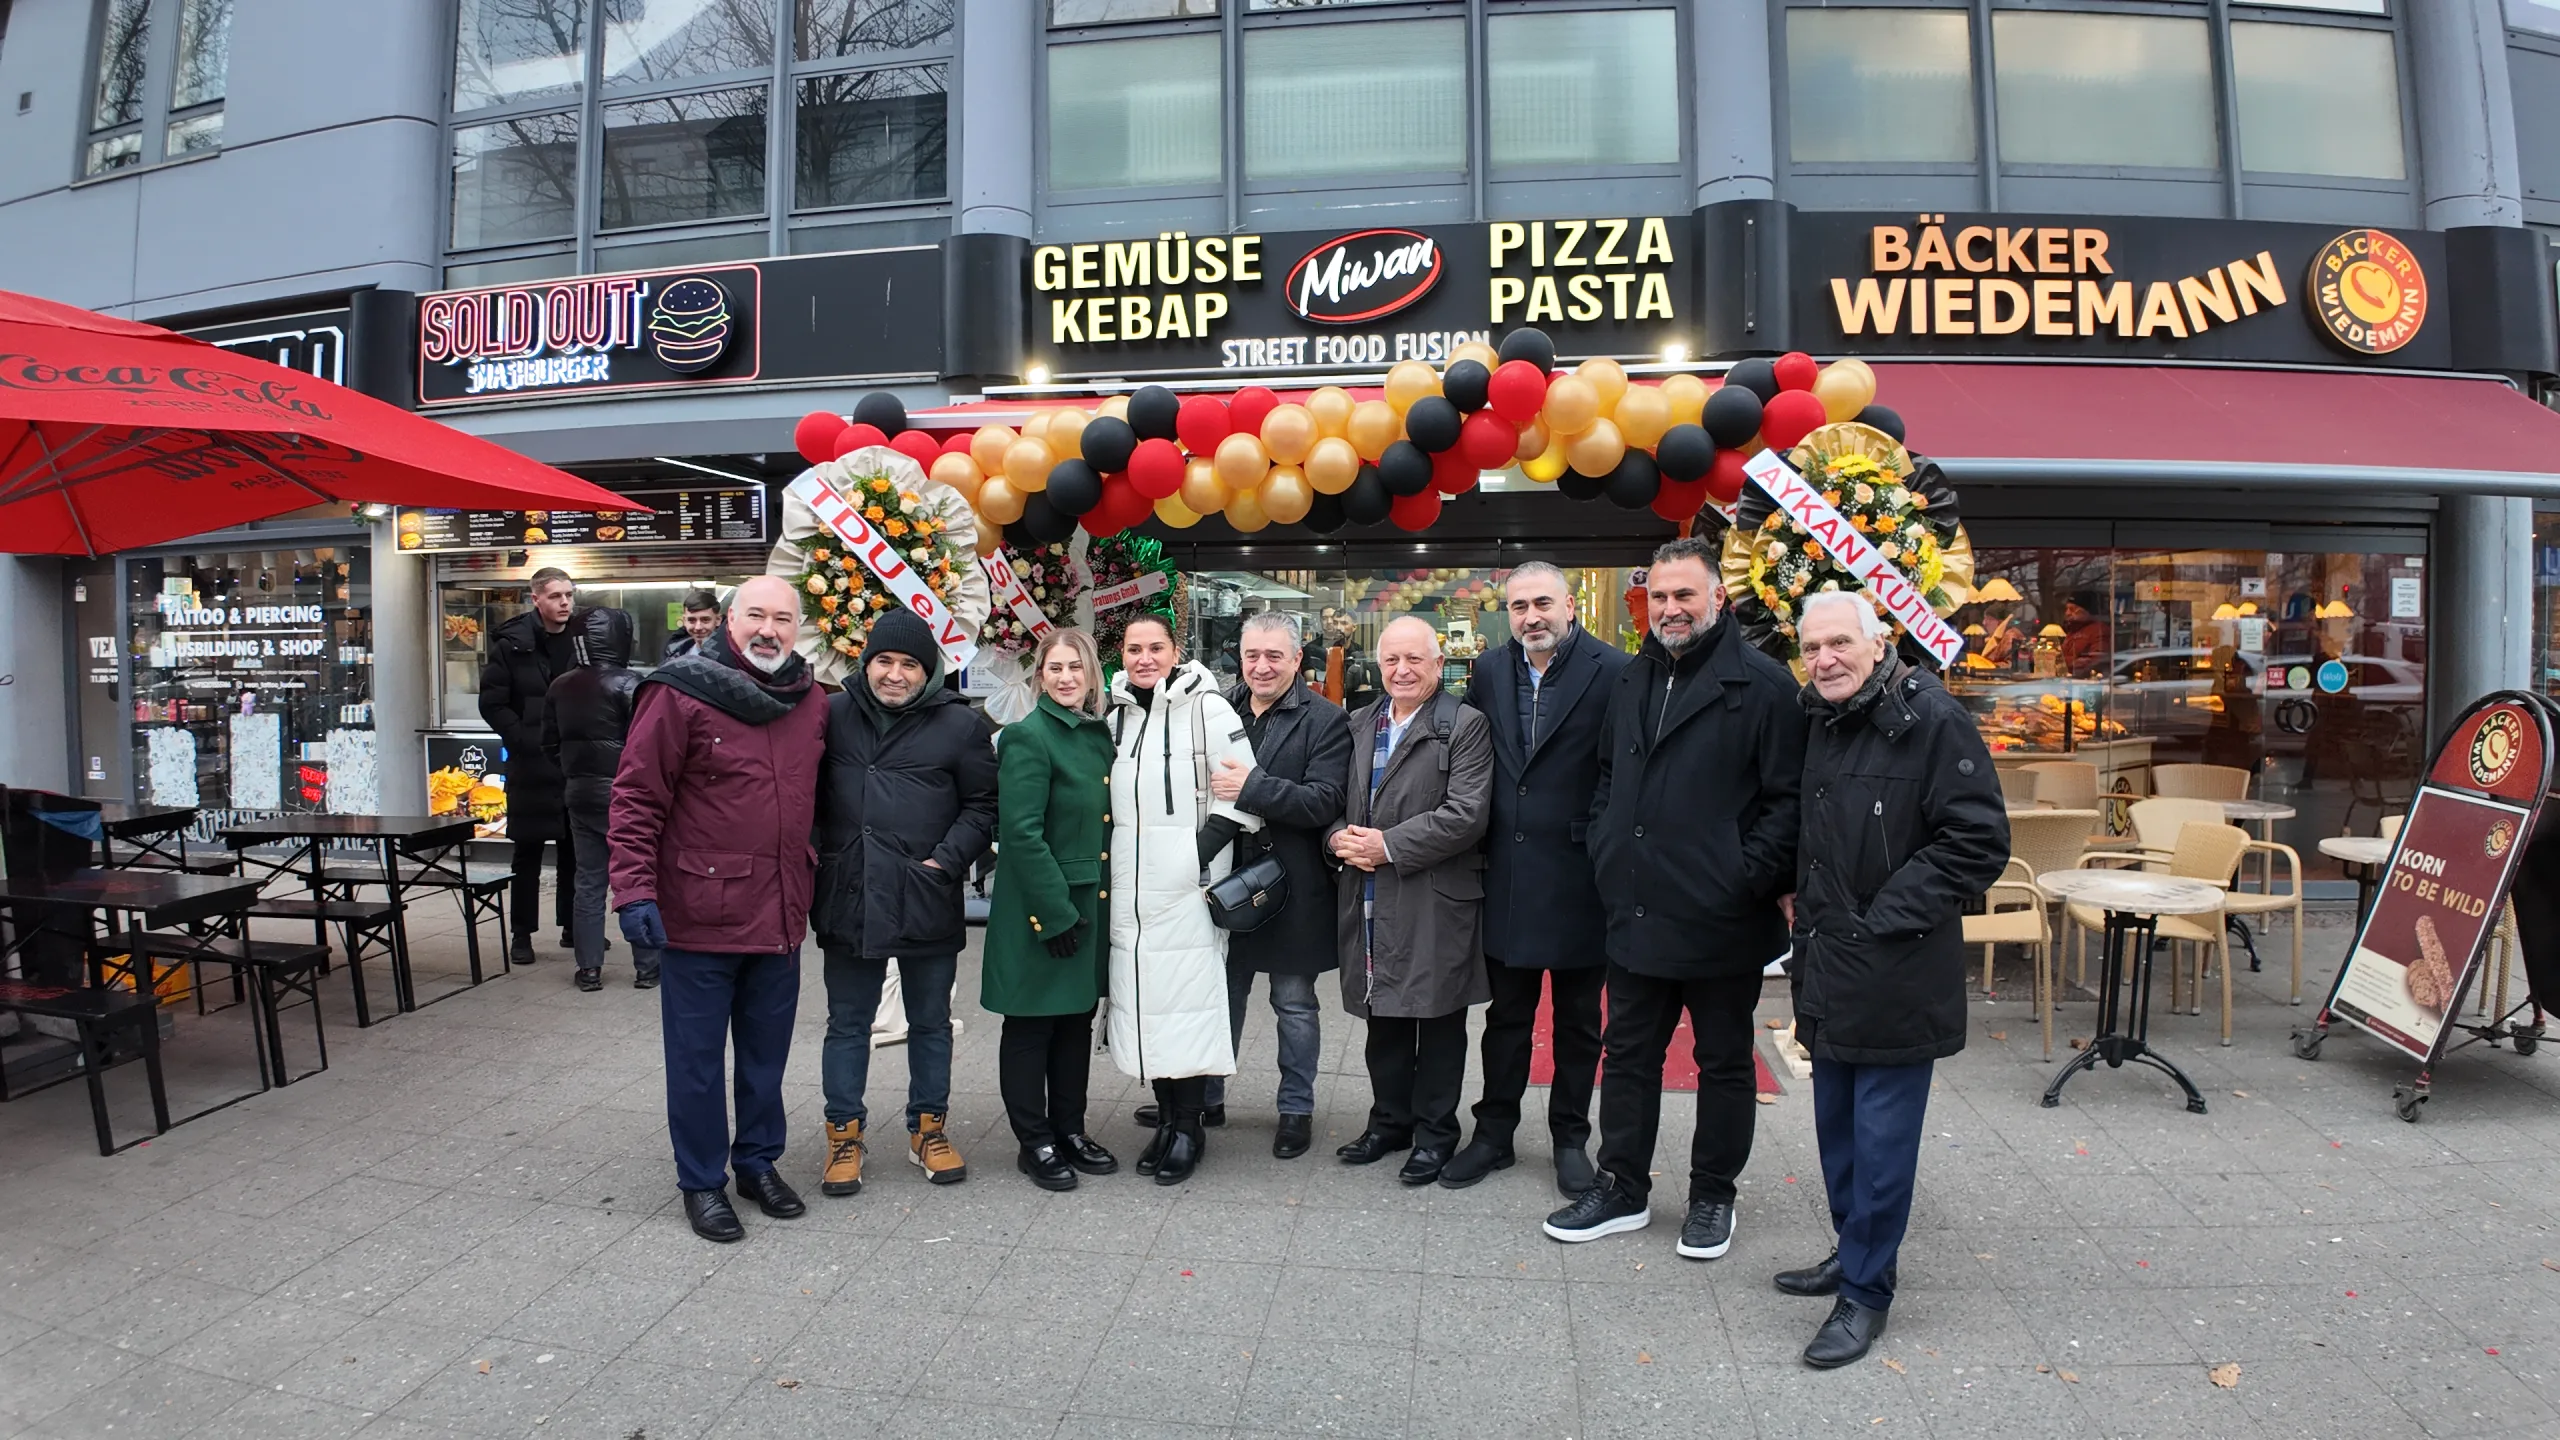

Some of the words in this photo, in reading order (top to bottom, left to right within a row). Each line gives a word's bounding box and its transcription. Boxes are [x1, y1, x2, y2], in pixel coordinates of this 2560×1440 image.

[1033, 231, 1262, 291] GEMÜSE
[1490, 217, 1674, 268] PIZZA
[1871, 214, 2113, 274] BÄCKER
[2325, 237, 2413, 278] BÄCKER
[1299, 238, 1434, 316] Miwan
[1490, 272, 1674, 324] PASTA
[1830, 250, 2287, 339] WIEDEMANN
[424, 289, 543, 362] SOLD
[546, 278, 640, 350] OUT
[1052, 292, 1228, 344] KEBAP
[2321, 282, 2419, 346] WIEDEMANN
[1221, 337, 1308, 368] STREET
[1315, 334, 1387, 364] FOOD
[810, 476, 908, 580] TDU
[910, 592, 967, 663] e.V.
[1755, 466, 1867, 566] AYKAN
[1864, 562, 1957, 661] KÜTÜK
[165, 607, 226, 626] TATTOO
[228, 607, 242, 625] &
[245, 605, 323, 624] PIERCING
[1120, 583, 1140, 599] GmbH
[167, 639, 259, 658] AUSBILDUNG
[263, 639, 276, 656] &
[279, 638, 324, 656] SHOP
[2482, 715, 2520, 742] BÄCKER
[2471, 741, 2518, 784] WIEDEMANN
[2399, 847, 2447, 877] KORN
[2392, 869, 2415, 892] TO
[2415, 878, 2440, 902] BE
[2442, 887, 2486, 918] WILD
